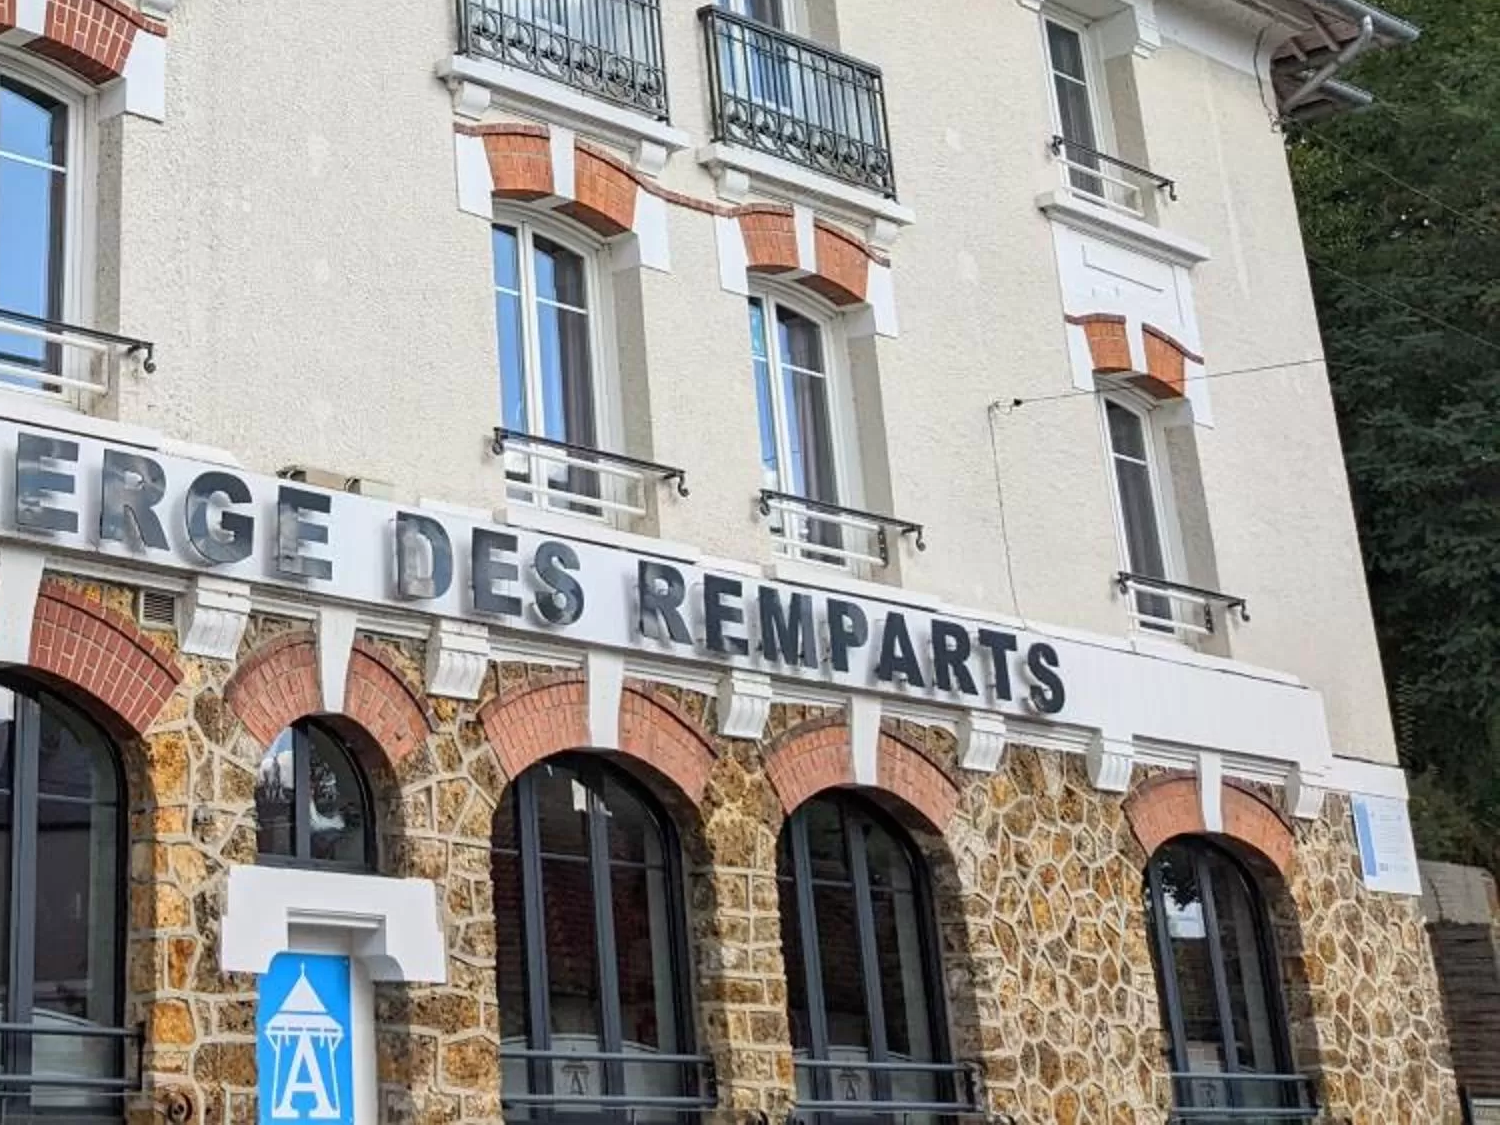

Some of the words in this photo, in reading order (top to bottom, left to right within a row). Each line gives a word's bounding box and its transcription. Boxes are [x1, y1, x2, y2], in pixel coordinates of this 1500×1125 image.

[394, 510, 585, 626] DES
[637, 560, 1067, 714] REMPARTS
[272, 1031, 340, 1118] A
